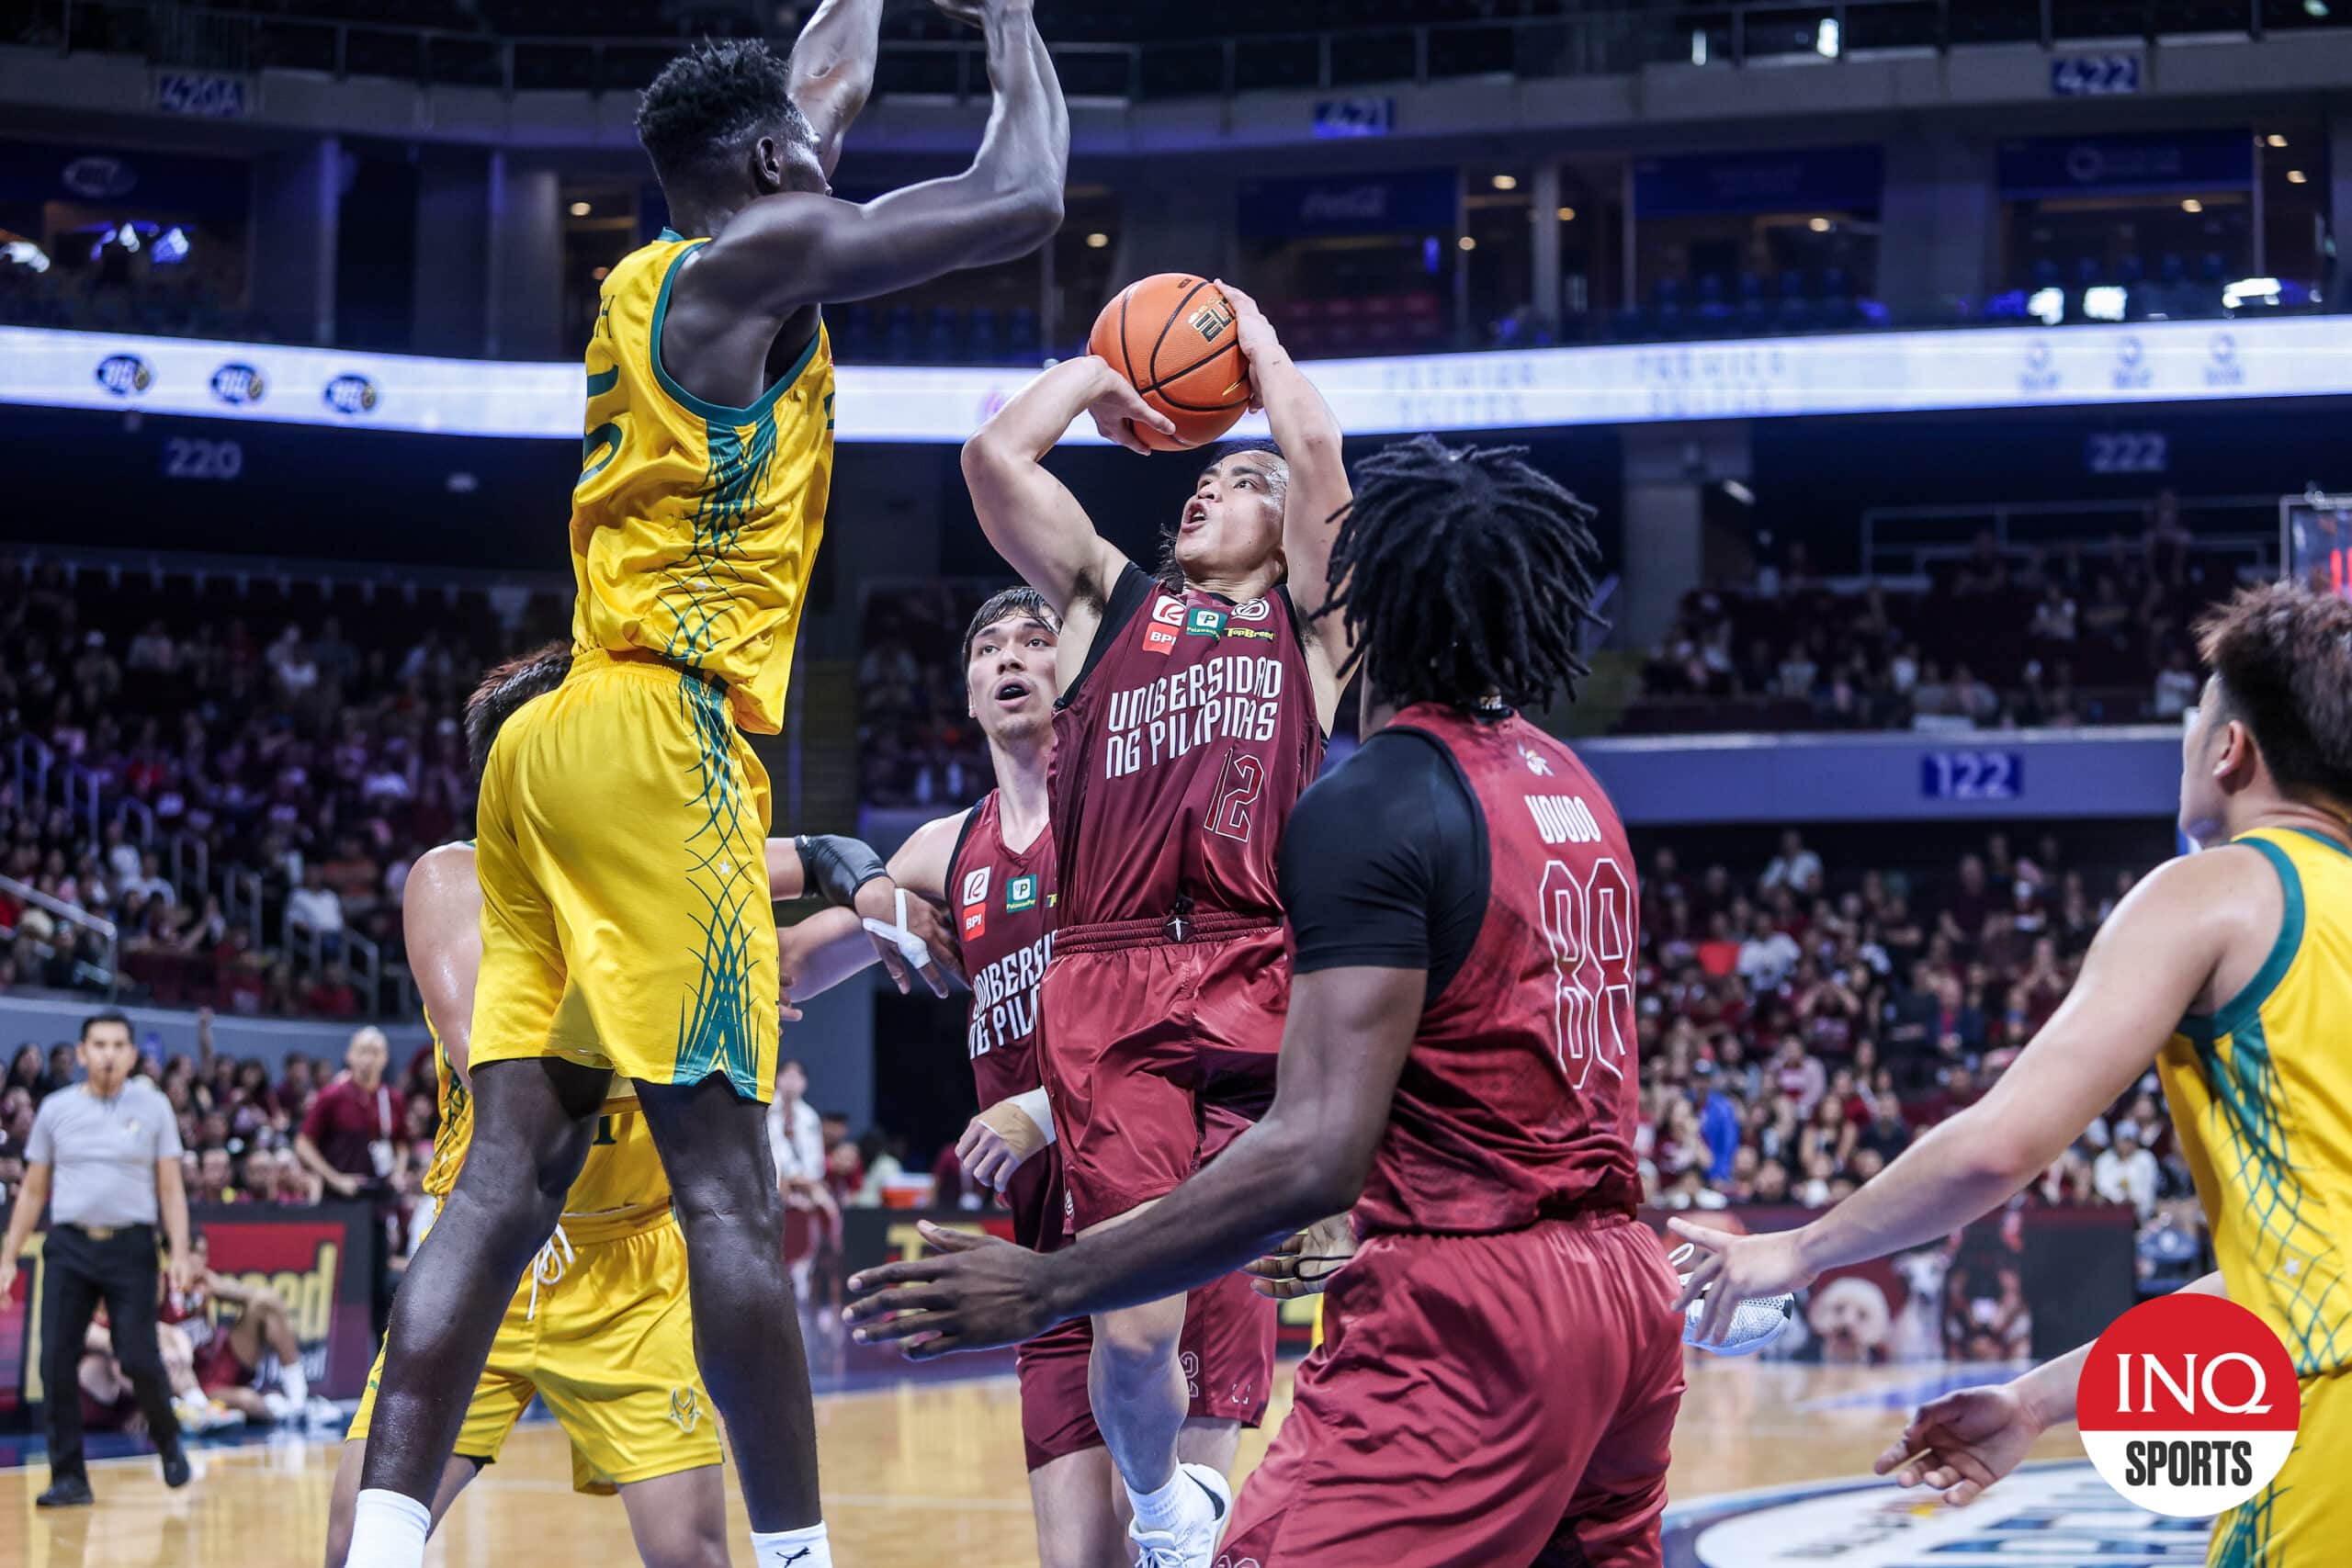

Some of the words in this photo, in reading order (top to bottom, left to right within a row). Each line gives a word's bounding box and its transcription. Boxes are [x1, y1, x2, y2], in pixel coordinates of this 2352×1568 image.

[2057, 57, 2132, 94] 422
[167, 438, 242, 479] 220
[2091, 433, 2165, 472] 222
[1149, 630, 1177, 646] BPI
[1108, 656, 1283, 733] UNIBERSIDAD
[1106, 728, 1141, 780] NG
[1149, 696, 1278, 766] PILIPINAS
[1204, 747, 1264, 843] 12
[1936, 751, 2009, 797] 122
[1523, 795, 1601, 844] UDUDO
[966, 914, 982, 931] BPI
[1539, 858, 1633, 1089] 88
